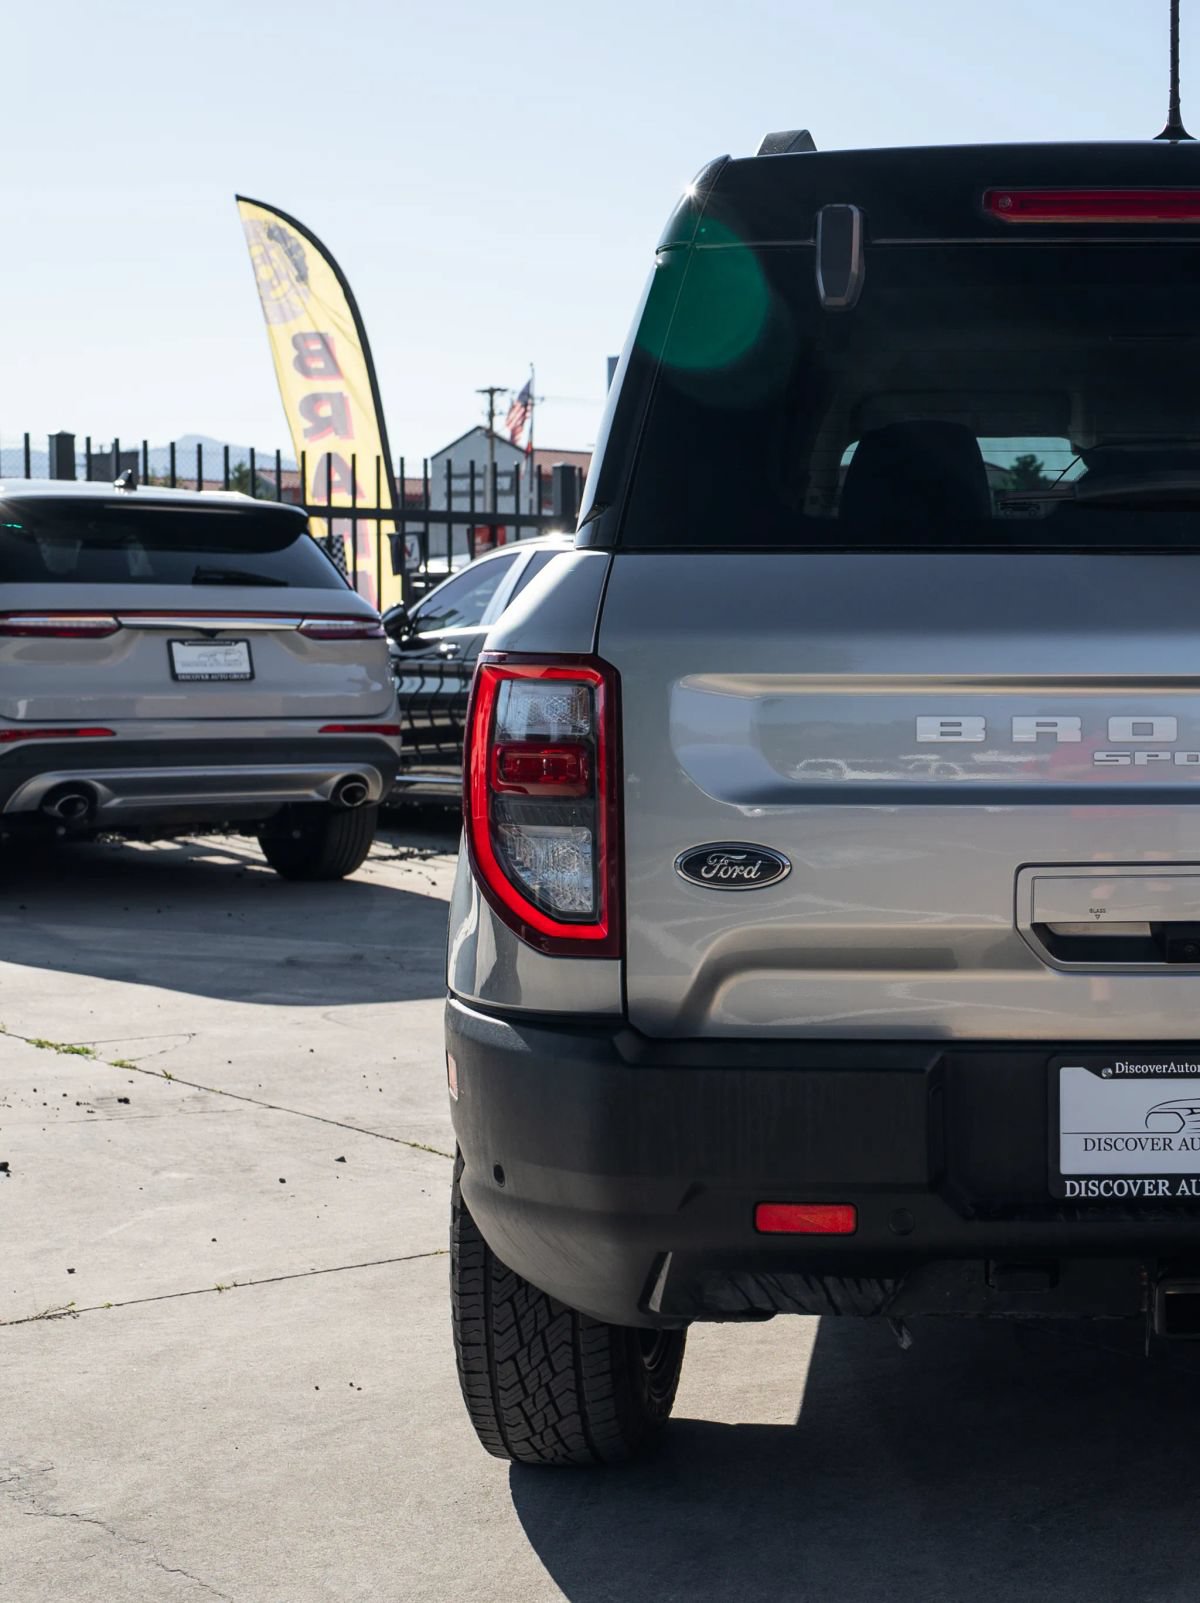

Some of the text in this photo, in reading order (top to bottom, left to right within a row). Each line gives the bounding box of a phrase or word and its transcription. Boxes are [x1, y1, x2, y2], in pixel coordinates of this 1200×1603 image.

[700, 852, 762, 879] Ford
[1083, 1137, 1174, 1152] DISCOVER
[1064, 1178, 1172, 1197] DISCOVER
